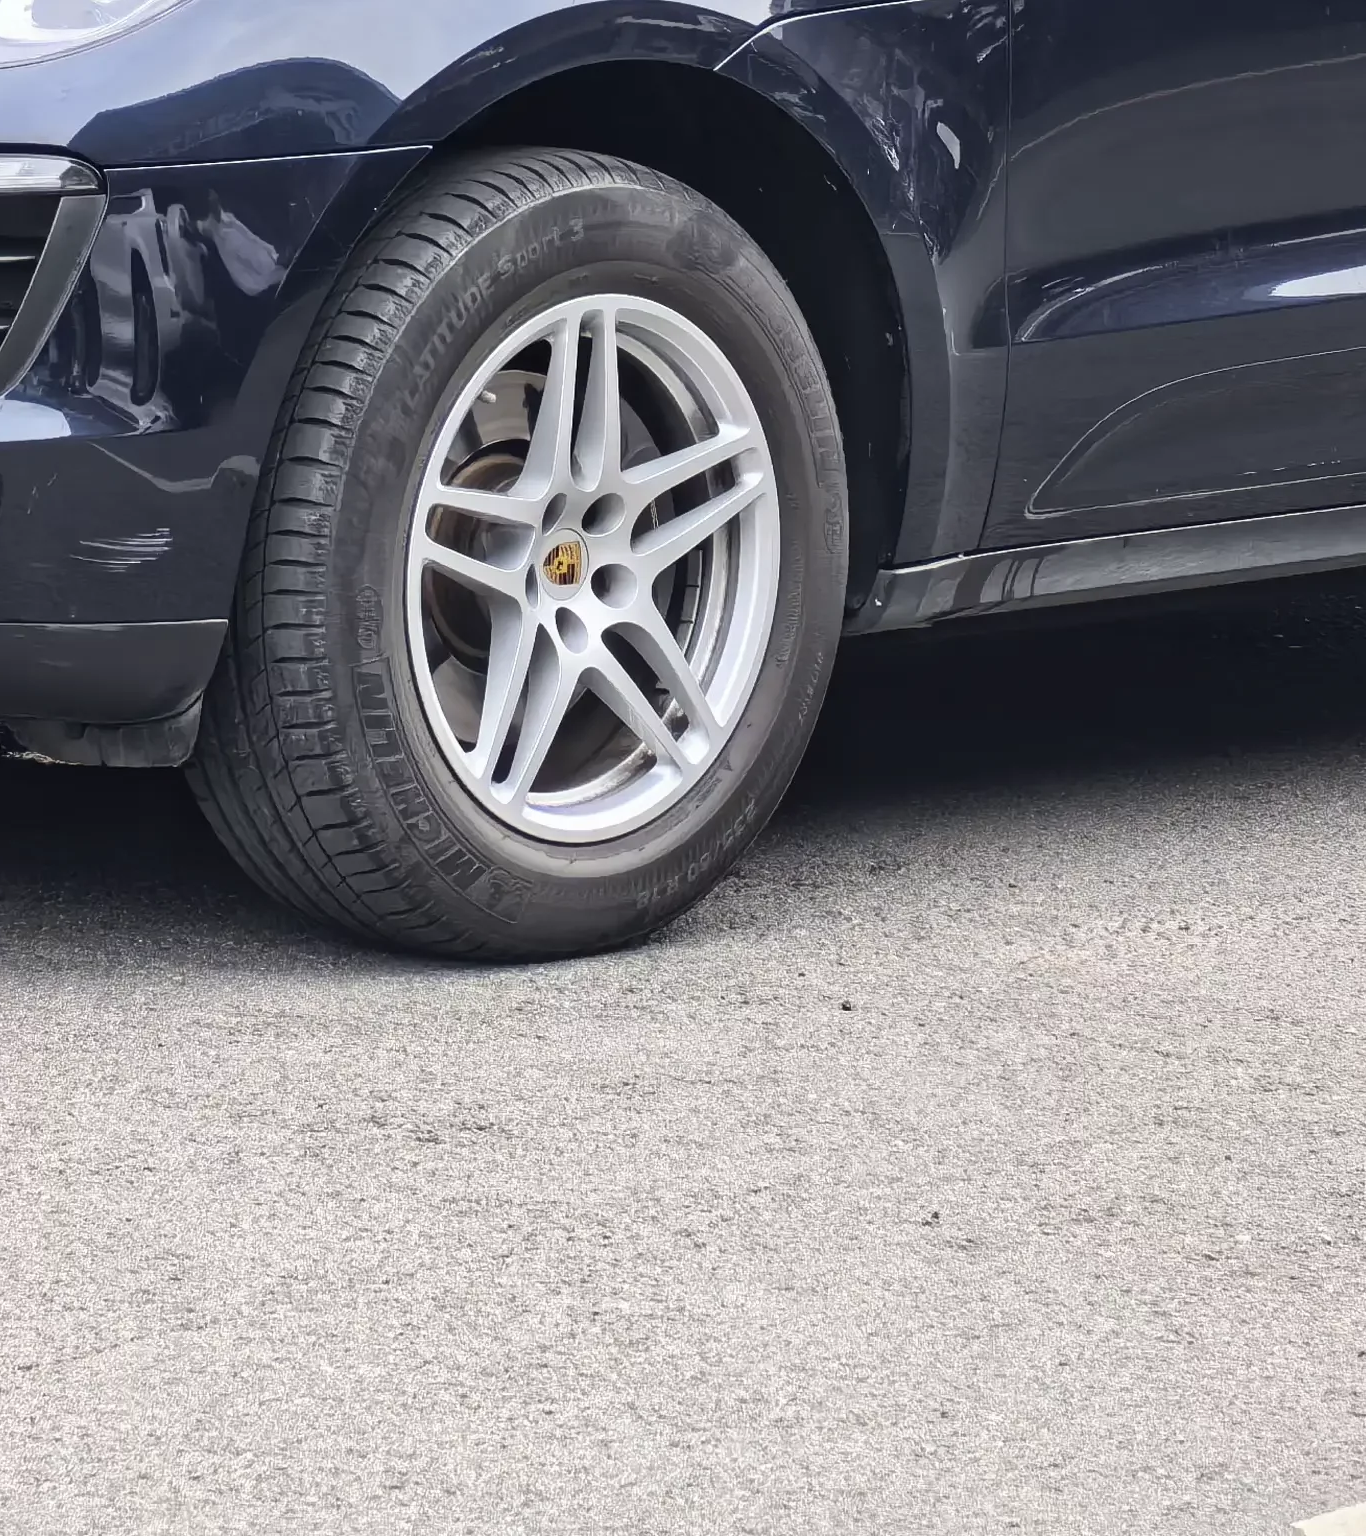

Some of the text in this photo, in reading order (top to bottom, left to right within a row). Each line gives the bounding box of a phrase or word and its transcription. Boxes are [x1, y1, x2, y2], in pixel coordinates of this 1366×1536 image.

[404, 215, 585, 408] LATITUDE Sport 3
[354, 668, 491, 892] MICHELIN
